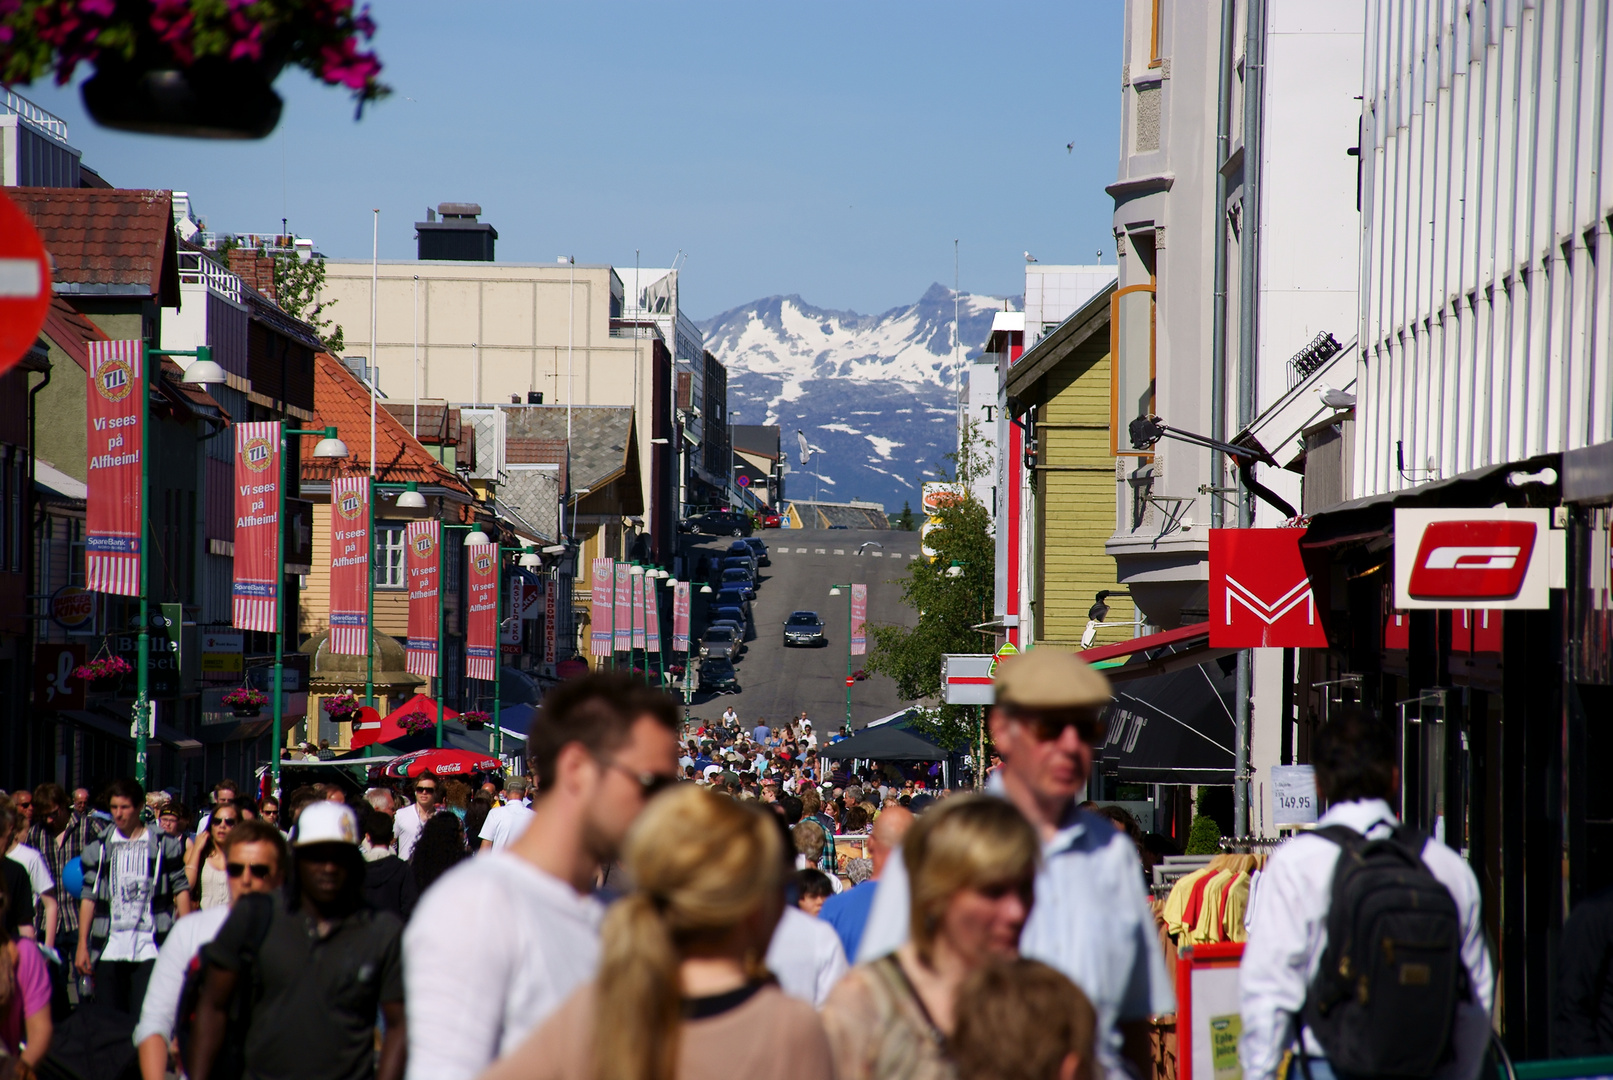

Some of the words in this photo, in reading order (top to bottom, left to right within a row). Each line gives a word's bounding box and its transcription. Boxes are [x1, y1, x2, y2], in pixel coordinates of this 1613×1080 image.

[104, 369, 126, 388] TIL
[93, 417, 106, 431] Vi
[108, 415, 136, 429] sees
[108, 433, 123, 451] på
[249, 445, 267, 461] TIL
[89, 449, 140, 470] Alfheim!
[240, 485, 250, 496] Vi
[252, 483, 275, 495] sees
[252, 498, 264, 513] på
[343, 497, 358, 511] TIL
[236, 511, 278, 528] Alfheim!
[335, 530, 344, 540] Vi
[345, 529, 366, 539] sees
[87, 537, 126, 546] SpareBank
[417, 539, 430, 551] TIL
[345, 542, 356, 554] på
[332, 553, 368, 568] Alfheim!
[477, 558, 489, 569] TIL
[411, 568, 419, 577] Vi
[420, 566, 437, 575] sees
[234, 583, 266, 591] SpareBank
[419, 577, 429, 589] på
[471, 583, 479, 592] Vi
[479, 582, 495, 591] sees
[410, 587, 438, 600] Alfheim!
[479, 592, 488, 602] på
[54, 595, 91, 607] BURGER
[54, 603, 91, 618] KING
[469, 602, 496, 613] Alfheim!
[546, 581, 555, 663] EIENDOMSMEGLING
[1280, 797, 1311, 809] 149.95
